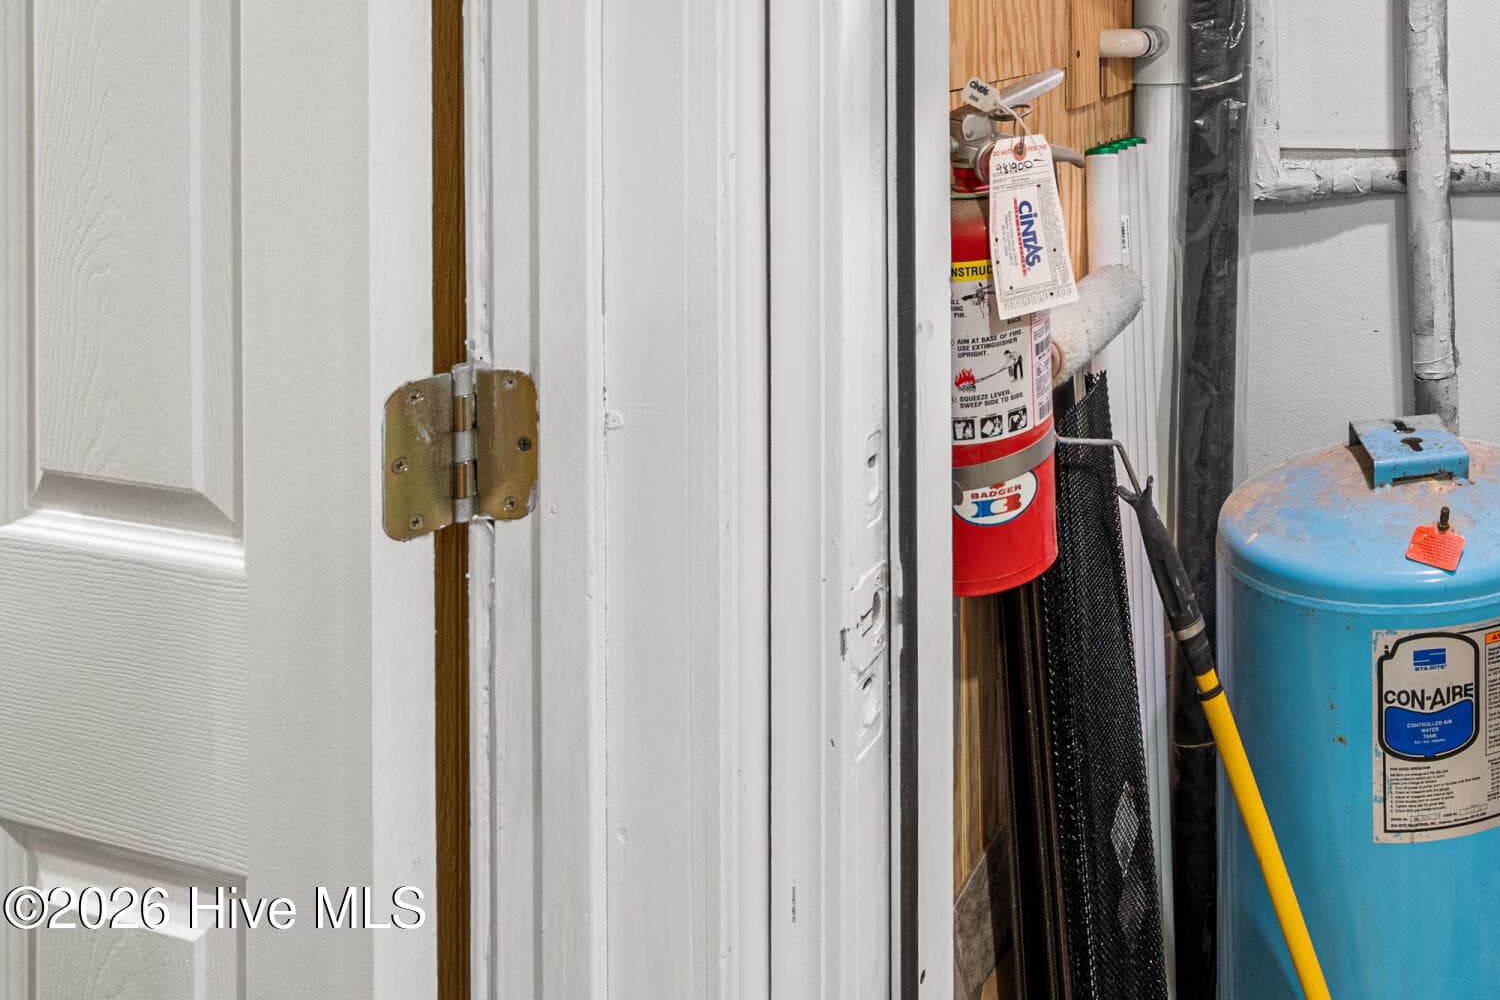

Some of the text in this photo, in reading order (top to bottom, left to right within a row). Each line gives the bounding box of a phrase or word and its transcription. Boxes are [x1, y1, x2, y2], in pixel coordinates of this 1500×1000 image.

[1018, 200, 1043, 267] CINTAS
[951, 265, 993, 278] NSTRUC
[957, 338, 970, 346] AIM
[981, 335, 998, 343] BASE
[957, 336, 1018, 352] USE EXTINGUISHER
[957, 351, 989, 359] UPRIGHT.
[960, 393, 989, 403] SQUEEZE
[960, 400, 983, 409] SWEEP
[984, 398, 1000, 407] SIDE
[1000, 396, 1009, 405] TO
[970, 484, 1022, 500] BADGER
[1384, 683, 1474, 711] CON-AIRE
[1406, 720, 1443, 729] CONTROLLED
